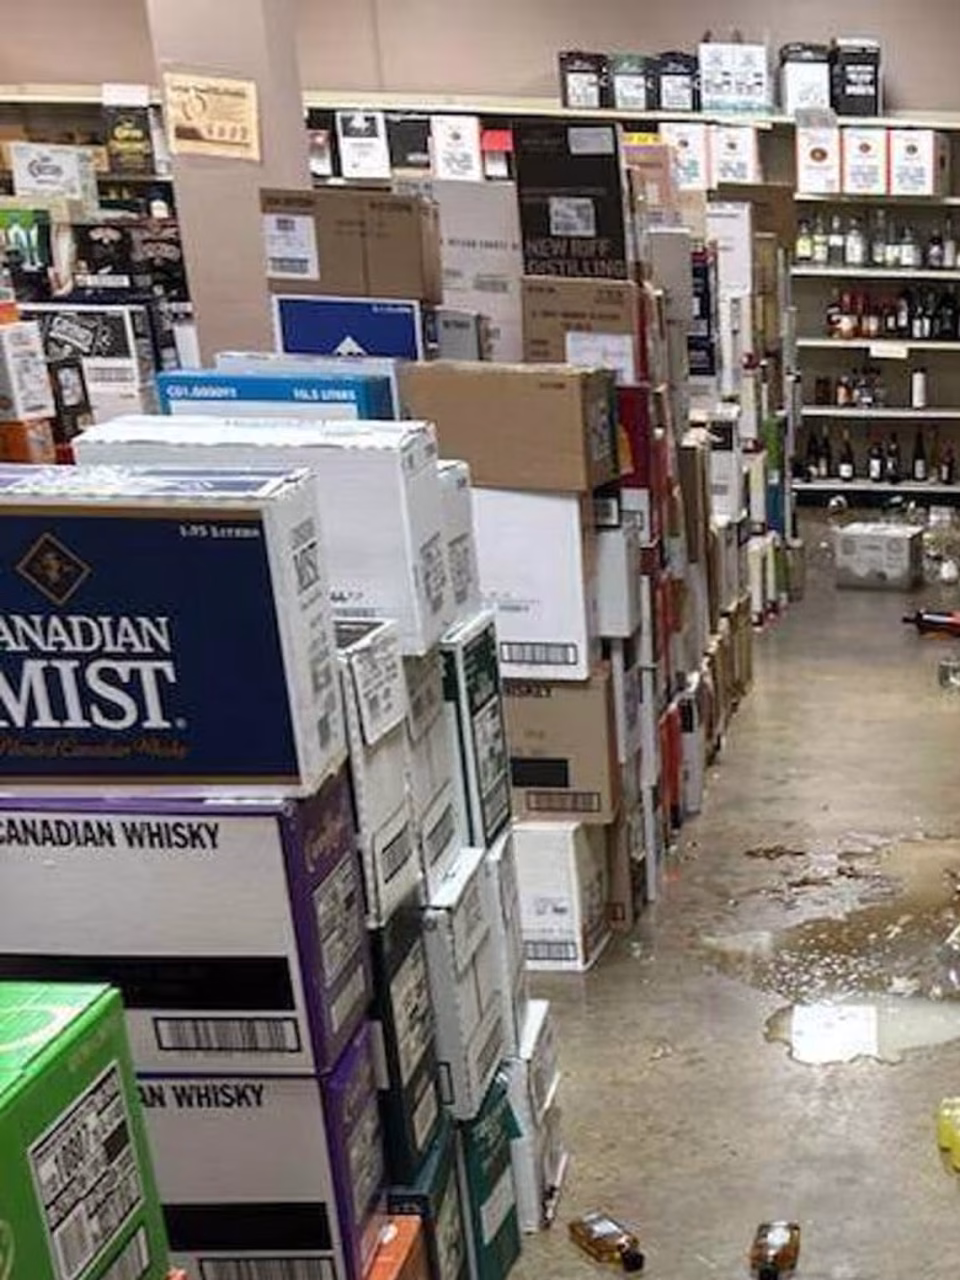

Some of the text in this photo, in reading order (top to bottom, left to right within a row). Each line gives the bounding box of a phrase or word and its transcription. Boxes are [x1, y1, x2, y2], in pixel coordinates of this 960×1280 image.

[0, 614, 171, 653] ANADIAN
[0, 659, 178, 730] MIST
[122, 822, 220, 849] WHISKY
[172, 1084, 264, 1109] WHISKY
